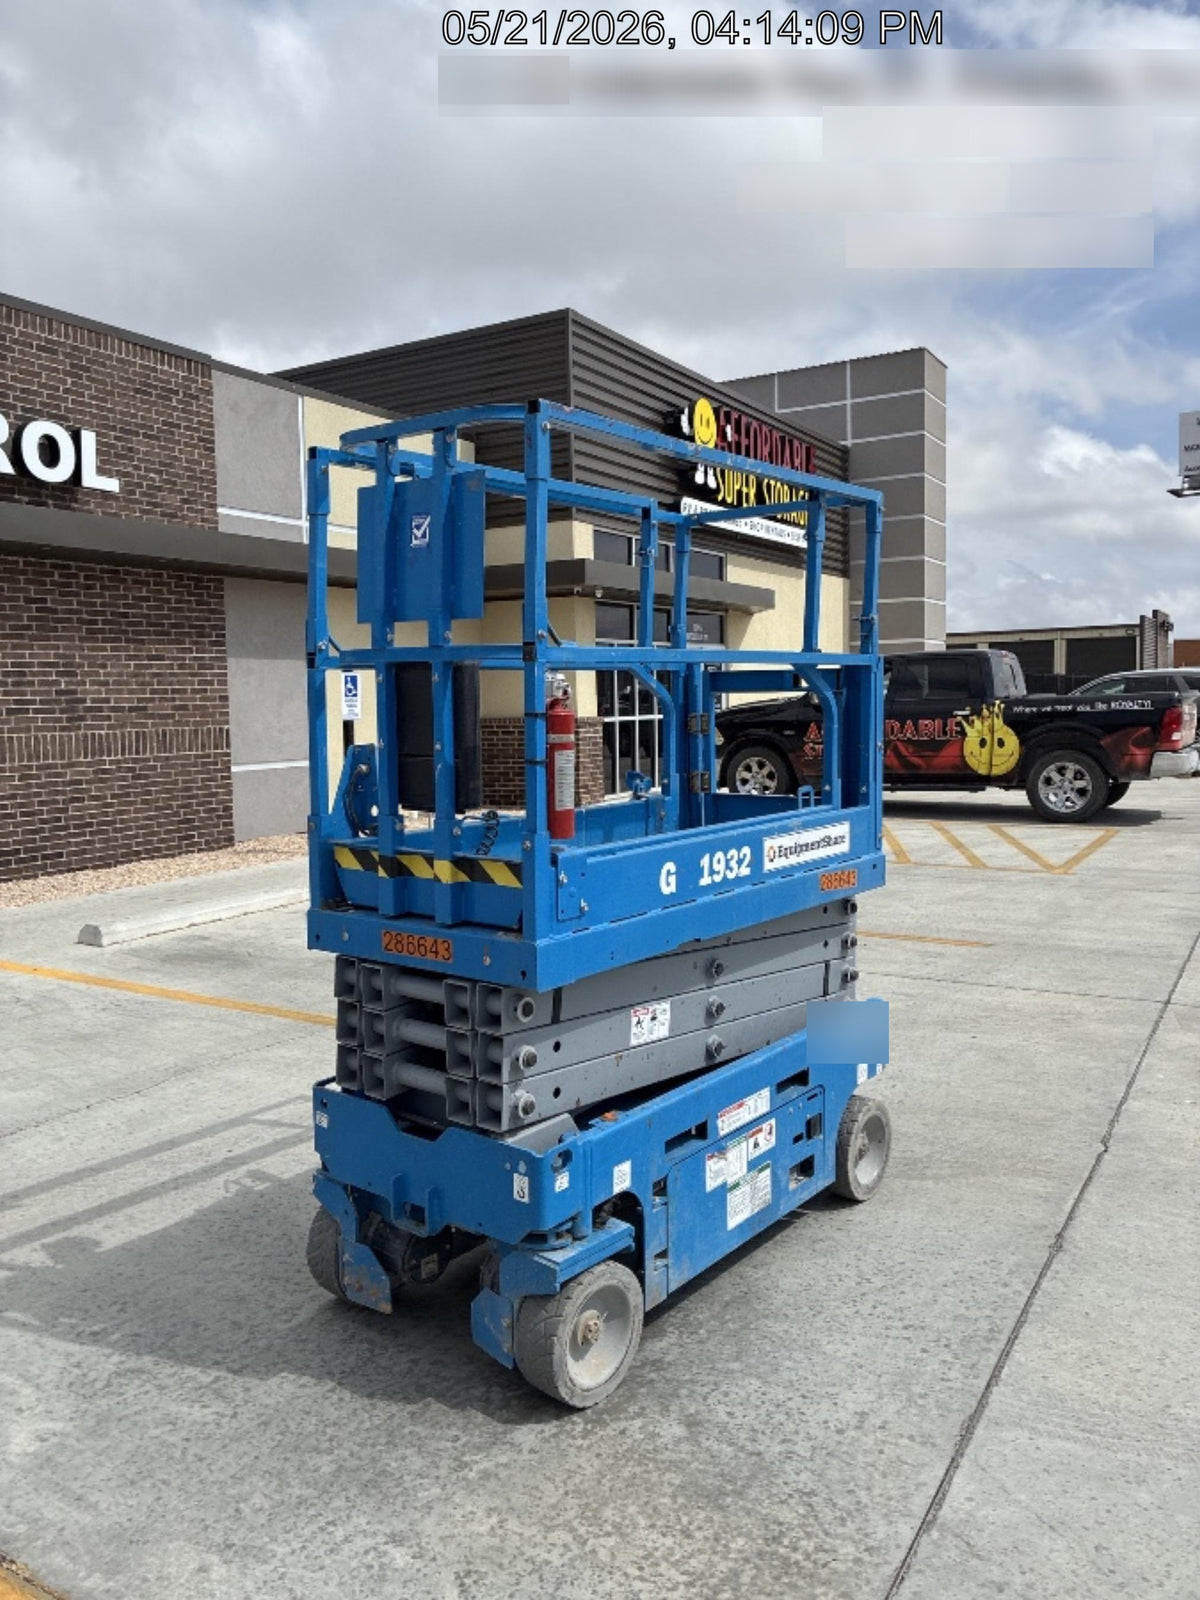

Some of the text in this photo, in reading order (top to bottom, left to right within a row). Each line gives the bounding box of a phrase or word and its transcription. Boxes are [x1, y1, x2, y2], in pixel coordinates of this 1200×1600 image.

[717, 467, 757, 508] SUPER
[777, 834, 847, 860] EquipmentShare
[660, 846, 751, 895] G 1932
[383, 931, 453, 961] 286643
